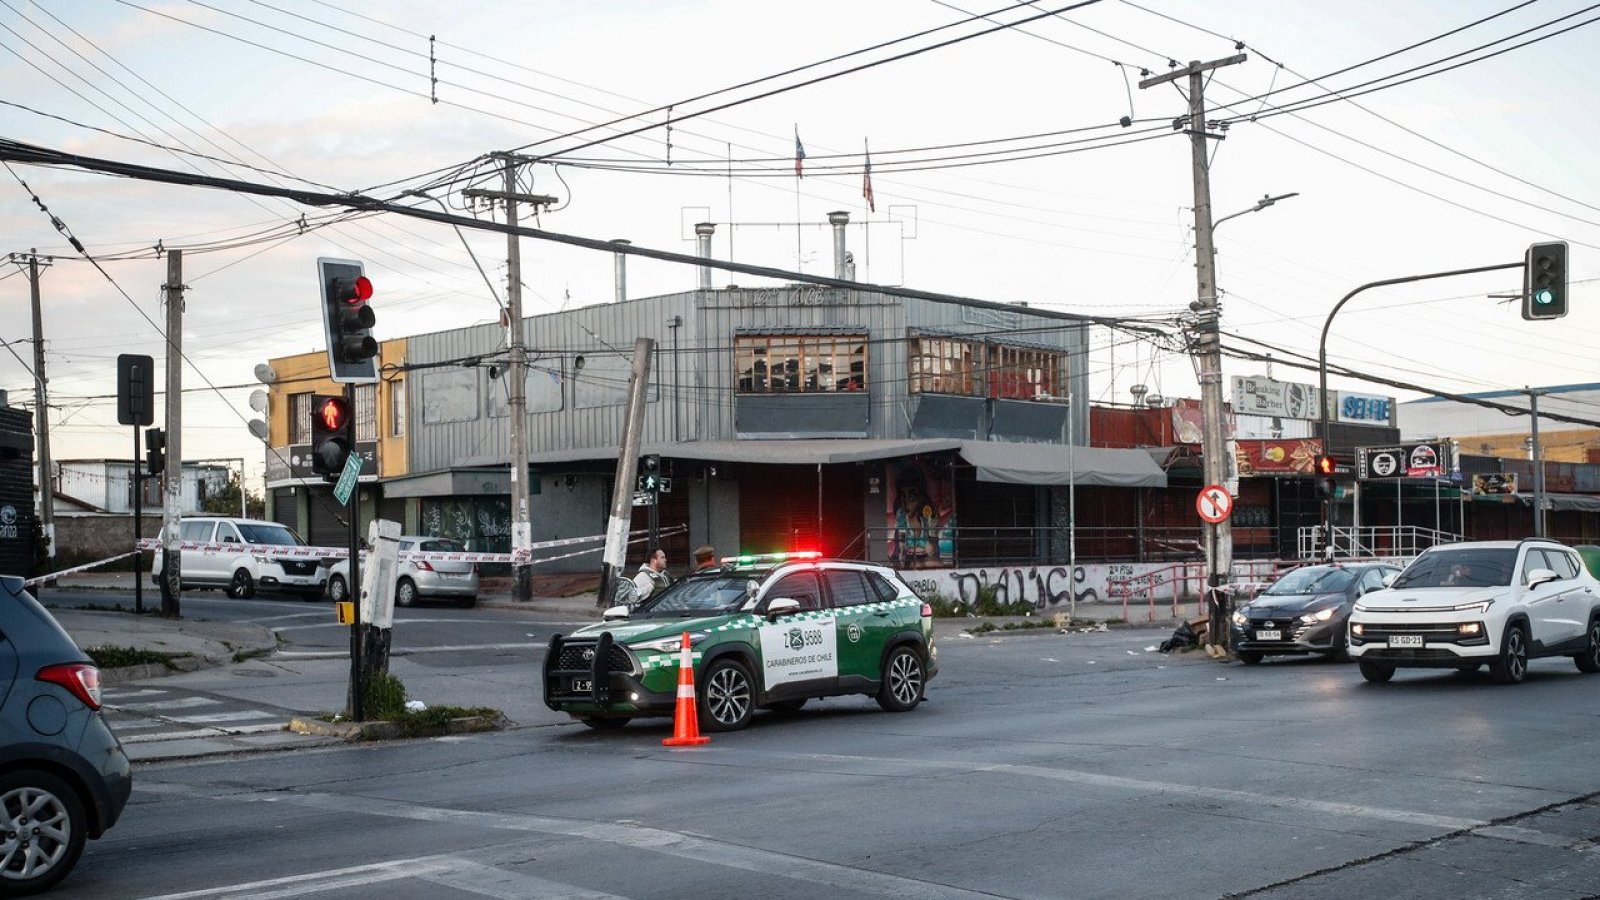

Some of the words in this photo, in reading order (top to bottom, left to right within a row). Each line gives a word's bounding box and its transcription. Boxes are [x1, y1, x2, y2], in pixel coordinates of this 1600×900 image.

[1246, 381, 1281, 397] Breaking
[1256, 395, 1282, 408] Barber
[766, 655, 807, 668] CARABINEROS
[808, 654, 816, 663] DE
[816, 653, 832, 662] CHILE
